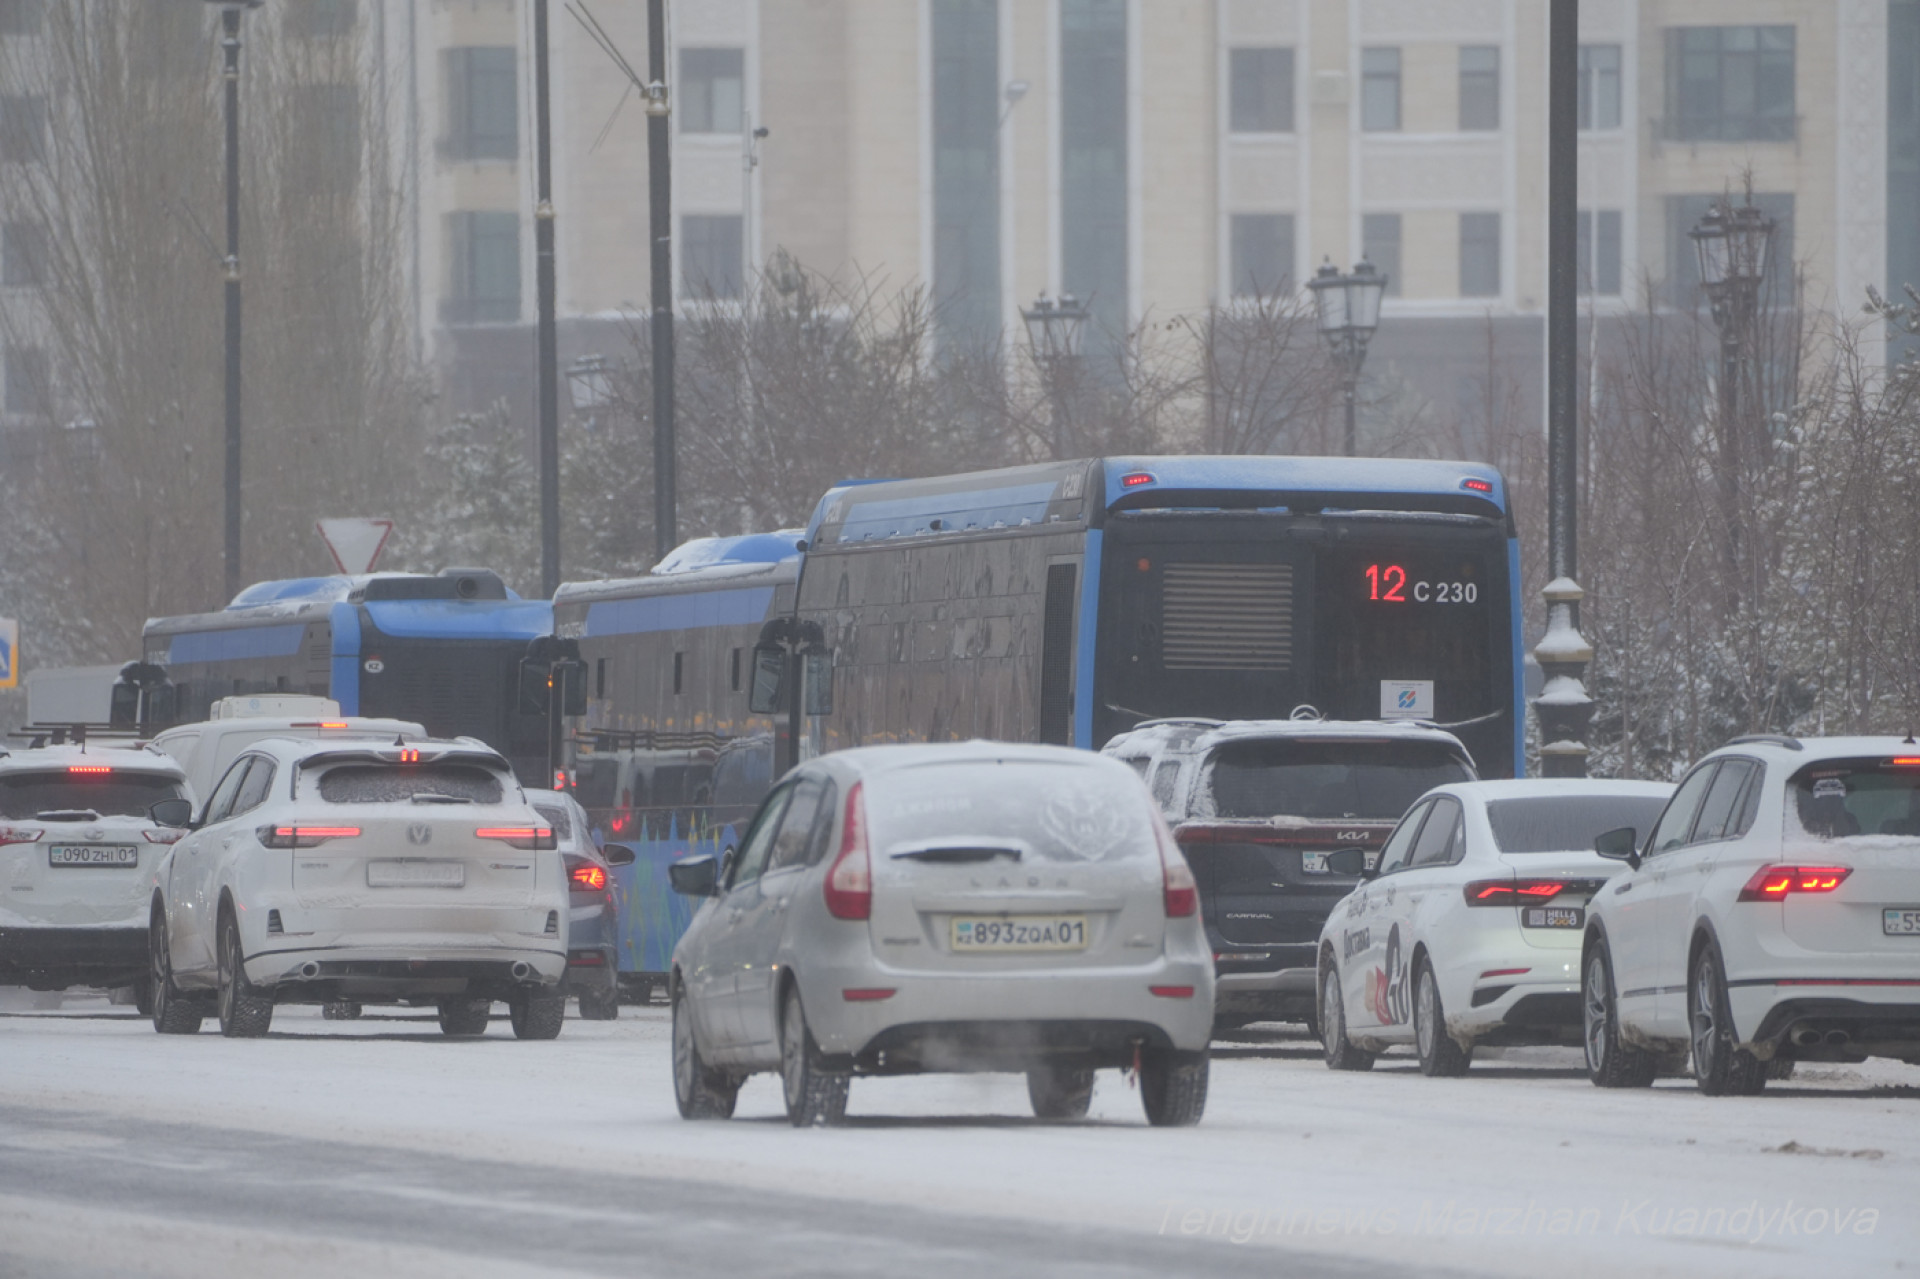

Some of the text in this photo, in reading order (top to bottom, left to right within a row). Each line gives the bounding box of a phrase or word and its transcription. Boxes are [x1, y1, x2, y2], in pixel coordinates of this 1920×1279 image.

[1366, 564, 1406, 602] 12
[1413, 581, 1478, 603] C 230
[1337, 831, 1370, 840] KIA
[63, 849, 90, 862] 090
[92, 850, 114, 862] ZHI
[118, 849, 135, 862] 01
[1547, 909, 1577, 918] HELLA
[1546, 917, 1577, 927] GOOD
[957, 921, 1085, 945] KZ 893 ZQA 01
